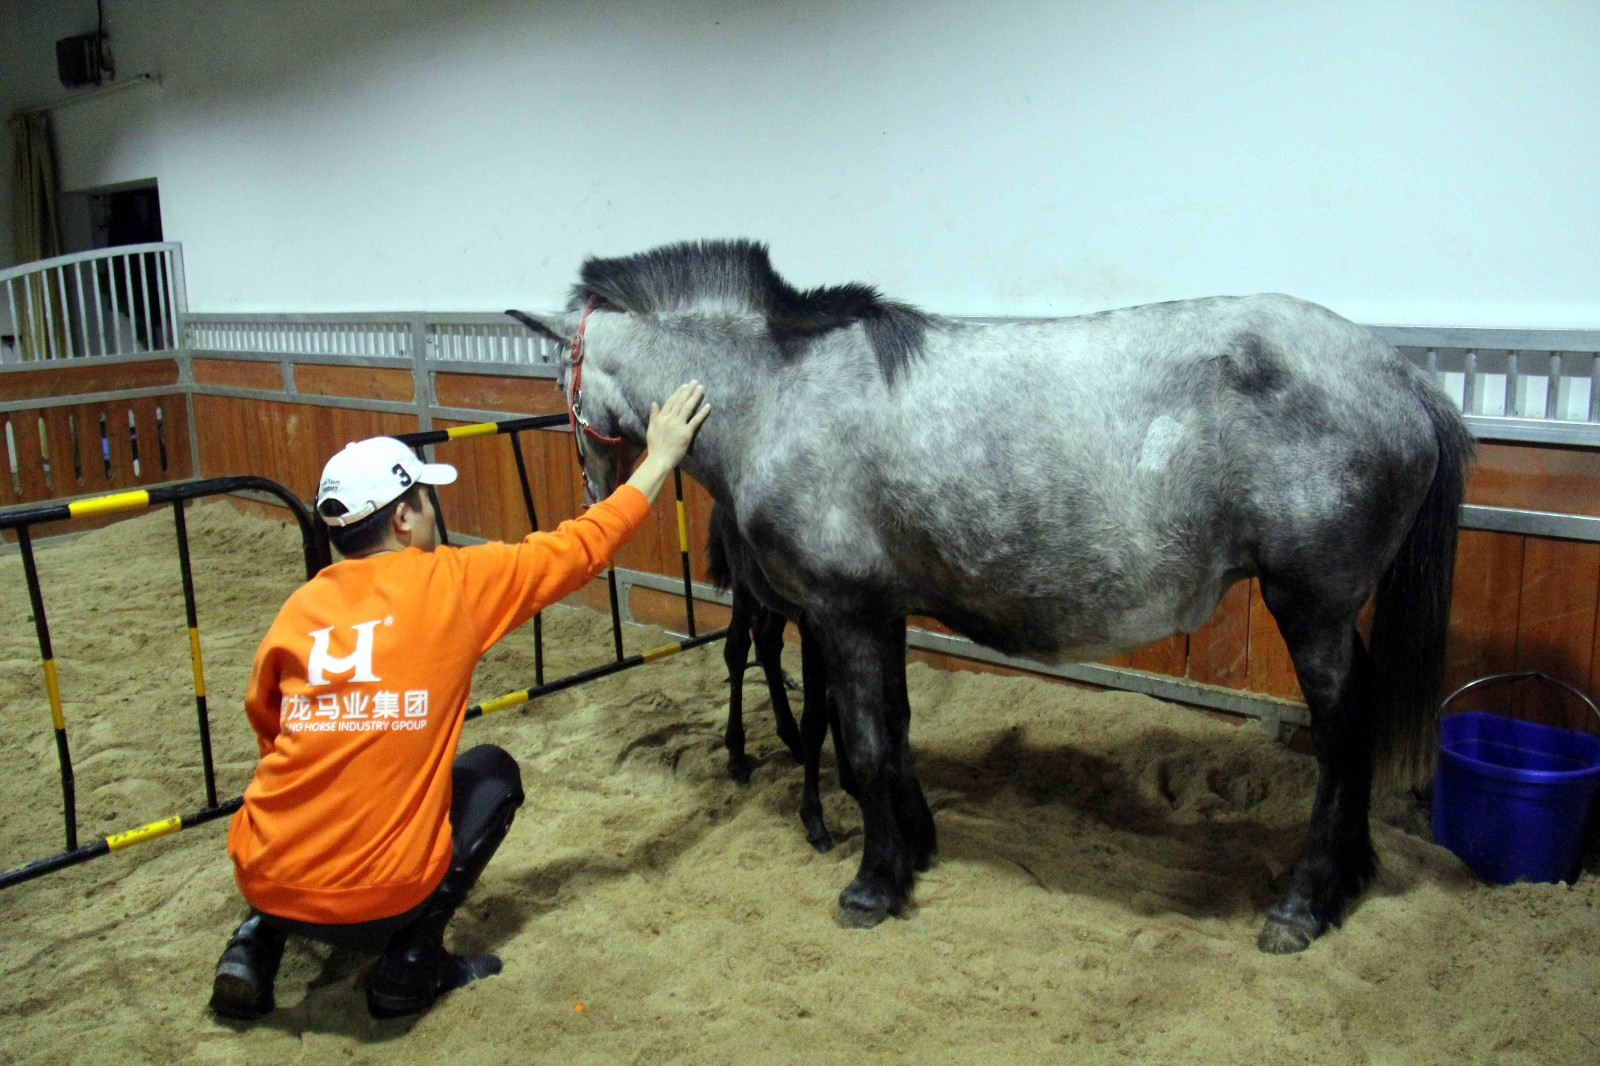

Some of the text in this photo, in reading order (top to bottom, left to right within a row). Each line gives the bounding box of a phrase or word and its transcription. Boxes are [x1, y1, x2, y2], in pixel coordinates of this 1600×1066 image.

[392, 464, 412, 487] 3
[304, 721, 337, 732] HORSE
[338, 720, 389, 731] INDUSTRY
